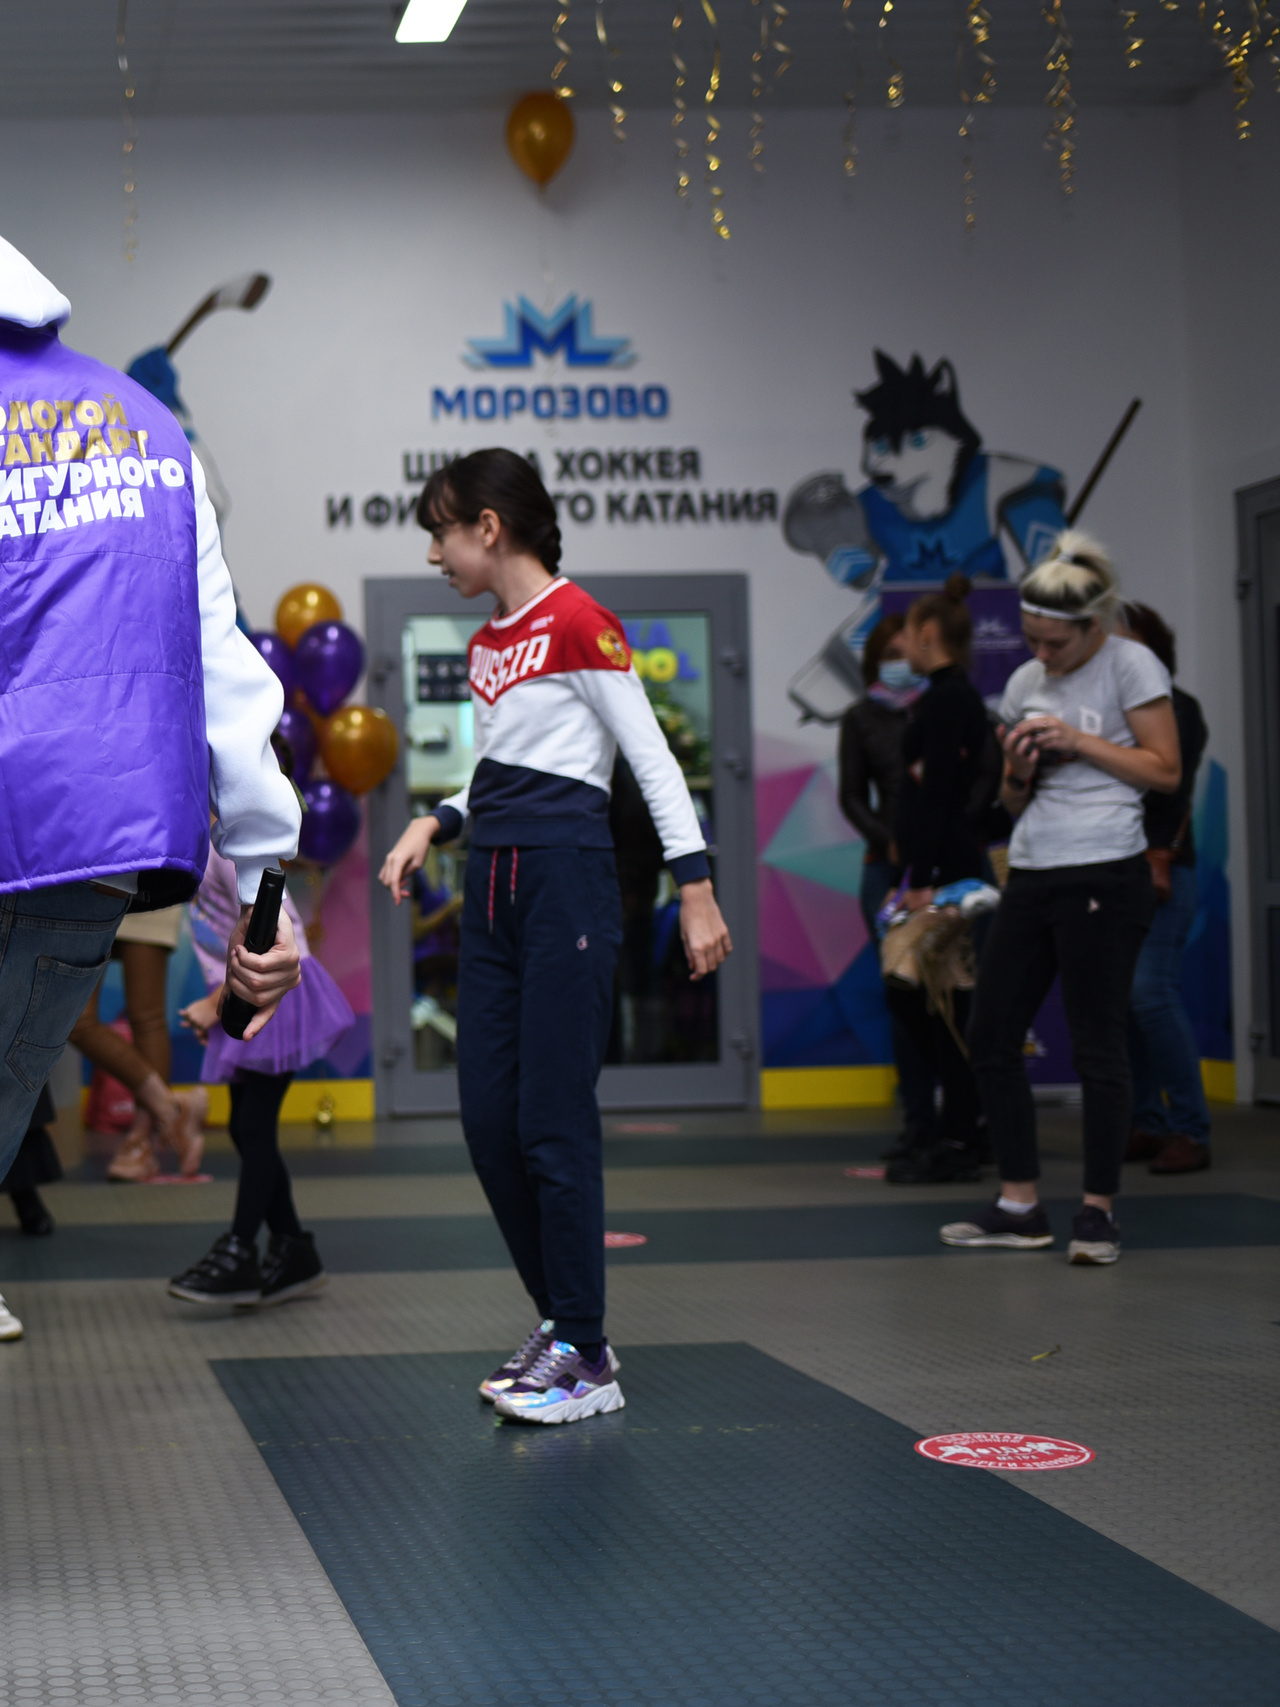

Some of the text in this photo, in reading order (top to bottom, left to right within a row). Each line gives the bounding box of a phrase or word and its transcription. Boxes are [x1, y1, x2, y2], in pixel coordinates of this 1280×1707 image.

[432, 384, 670, 420] МОРОЗОВО
[555, 449, 702, 482] ХОККЕЯ
[327, 496, 352, 528] И
[606, 491, 779, 523] КАТАНИЯ
[469, 634, 552, 701] RUSSIA
